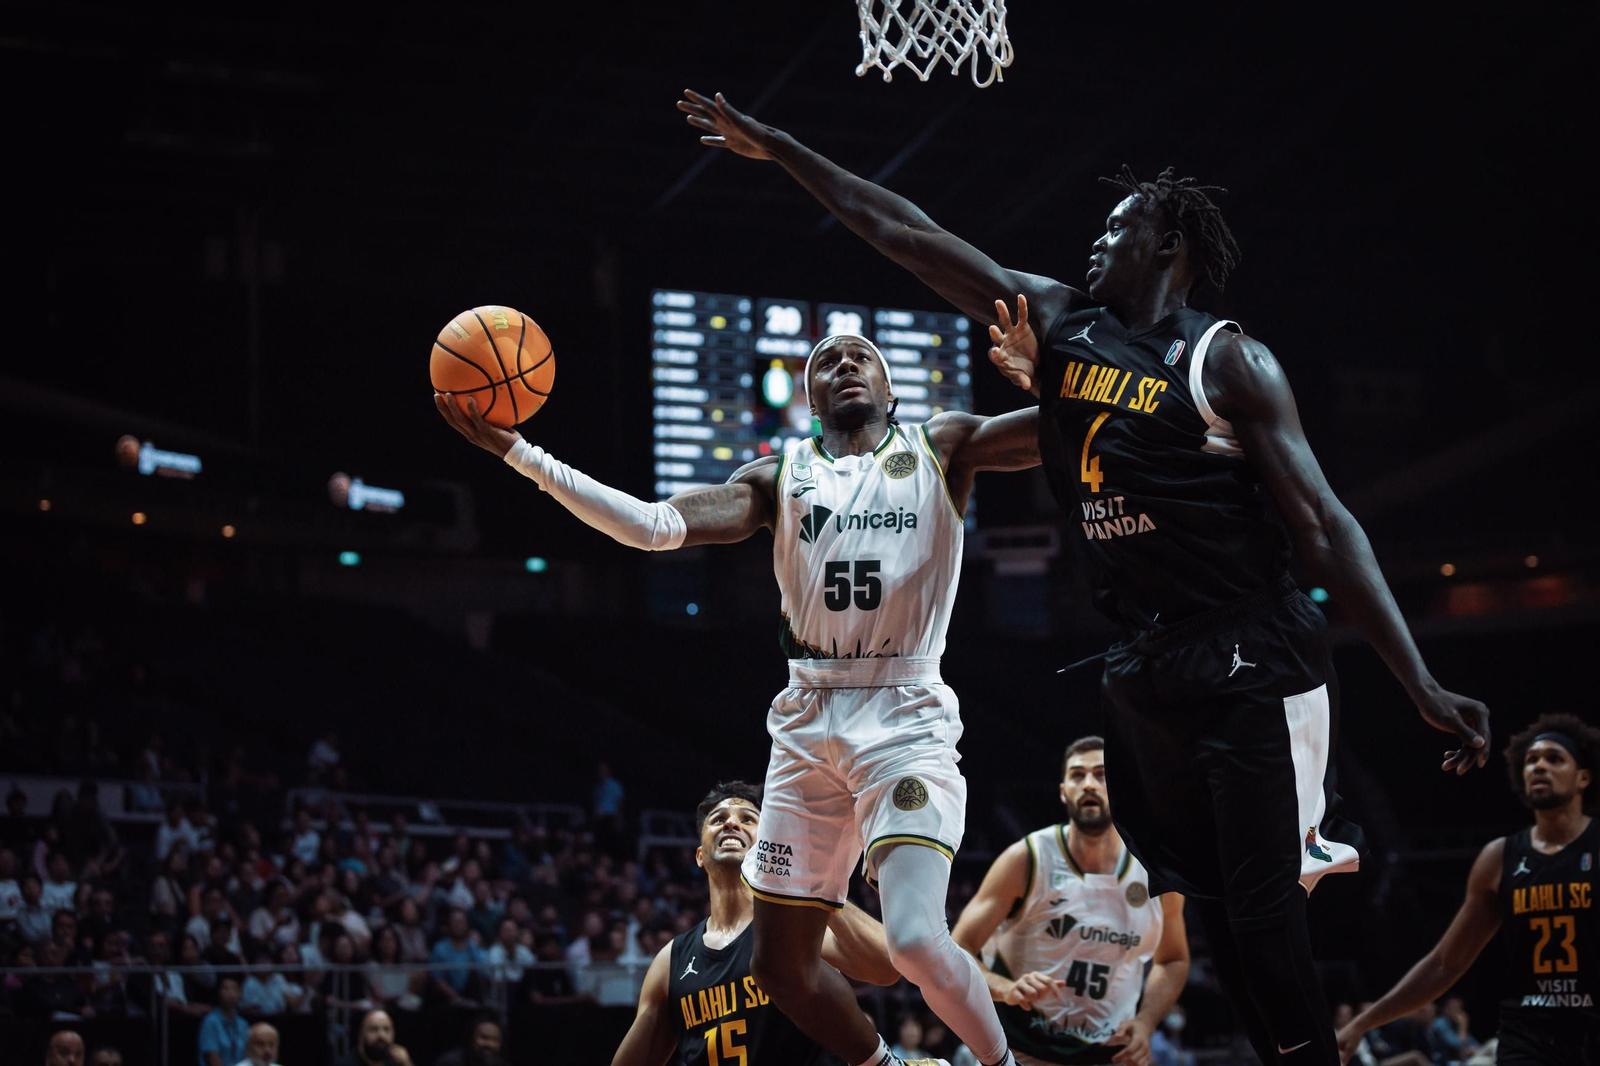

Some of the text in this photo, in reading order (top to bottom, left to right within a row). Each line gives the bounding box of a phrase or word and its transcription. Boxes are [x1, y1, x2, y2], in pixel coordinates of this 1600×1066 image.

[1060, 361, 1168, 413] ALAHLI SC
[1081, 411, 1112, 493] 4
[1081, 496, 1125, 520] VISIT
[824, 560, 882, 612] 55
[757, 851, 792, 867] DEL SOL
[758, 839, 793, 856] COSTA
[1512, 882, 1592, 915] ALAHLI SC
[1079, 925, 1142, 950] Unicaja
[1529, 915, 1579, 974] 23
[1065, 959, 1110, 1001] 45
[1536, 979, 1577, 993] VISIT
[680, 981, 737, 1030] ALAHLI
[1521, 993, 1594, 1008] RWANDA
[703, 1018, 748, 1066] 15
